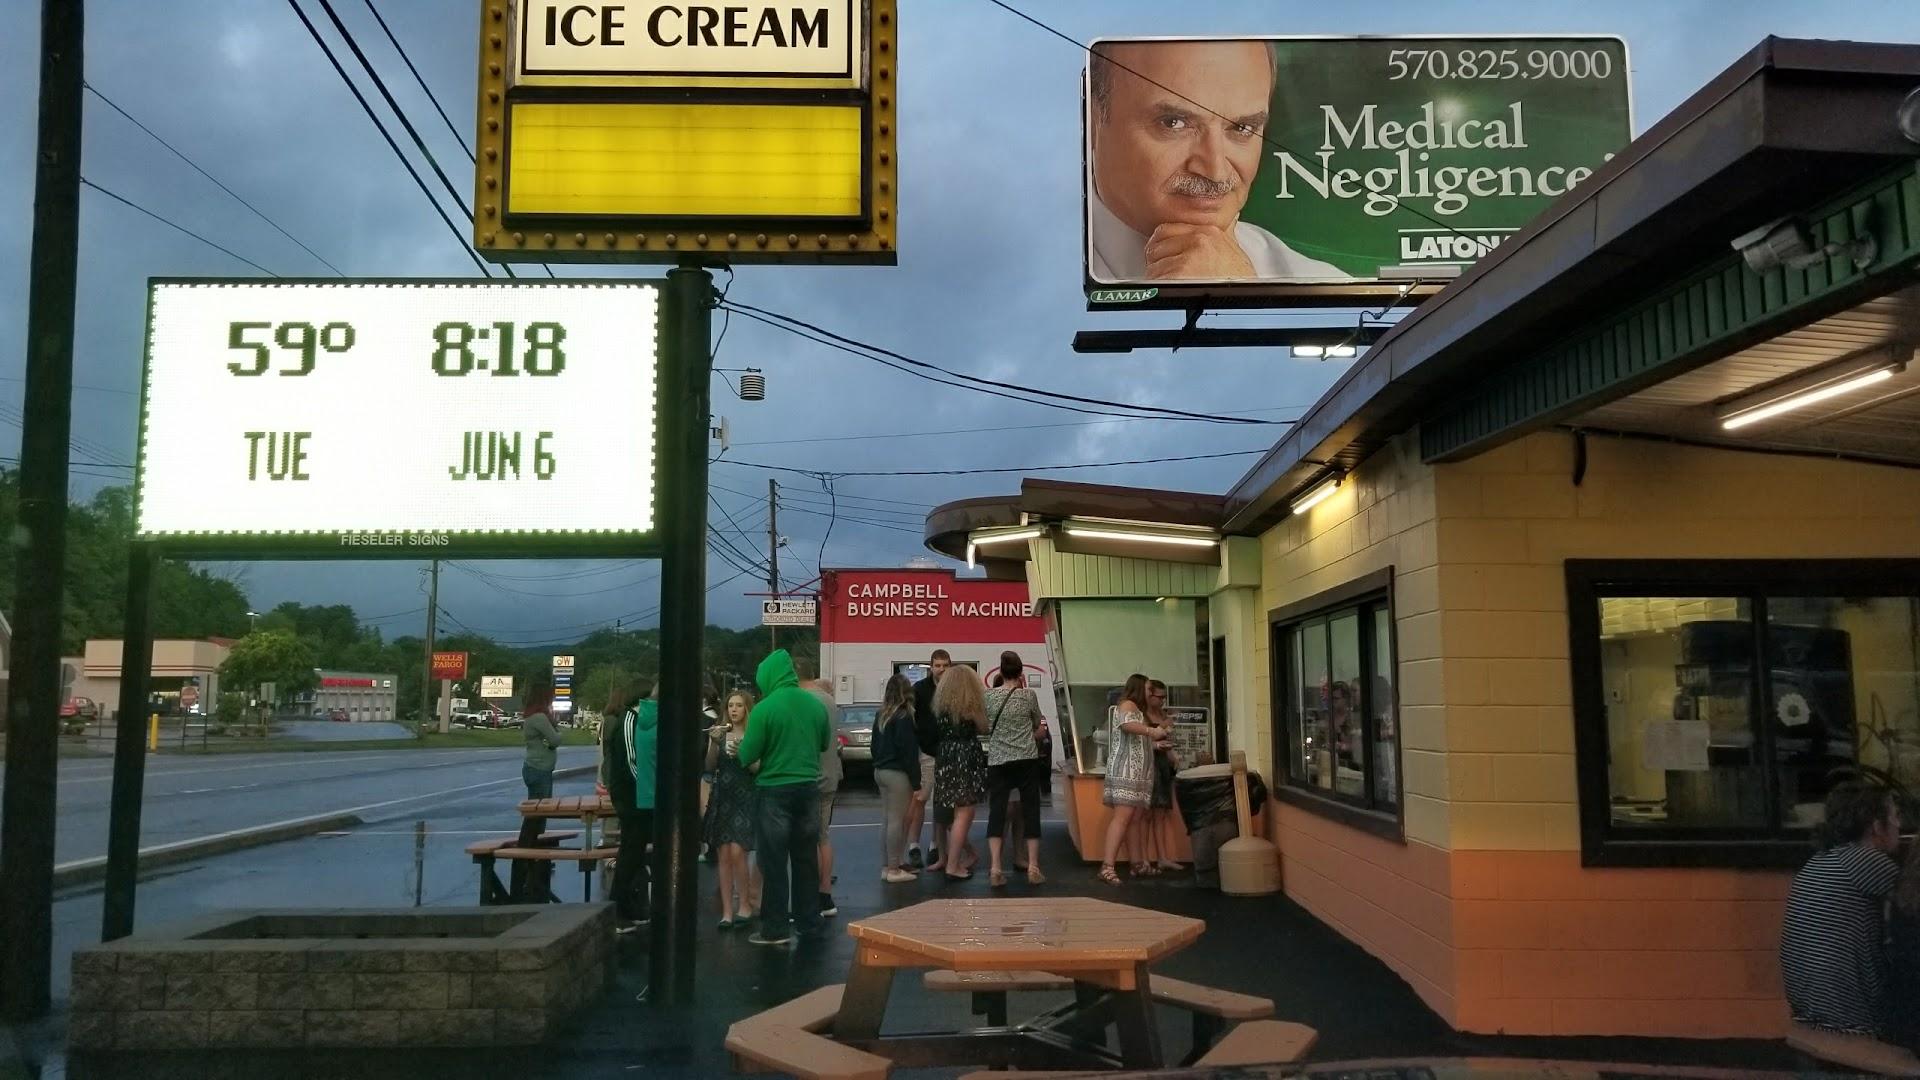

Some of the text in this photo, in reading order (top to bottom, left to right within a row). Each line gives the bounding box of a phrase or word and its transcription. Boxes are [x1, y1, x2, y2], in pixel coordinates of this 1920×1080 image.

[545, 5, 829, 48] ICE CREAM
[1388, 49, 1612, 81] 570.825.9000
[1320, 101, 1528, 150] Medical
[1401, 235, 1512, 260] LATON
[1096, 290, 1152, 300] LAMAR
[431, 321, 567, 377] 8:18
[244, 431, 556, 481] TUE JUN 6
[341, 534, 449, 545] FIESELER SIGNS
[848, 583, 949, 599] CAMPBELL
[848, 602, 1042, 617] BUSINESS MACHINE
[1177, 712, 1203, 720] PEPSI
